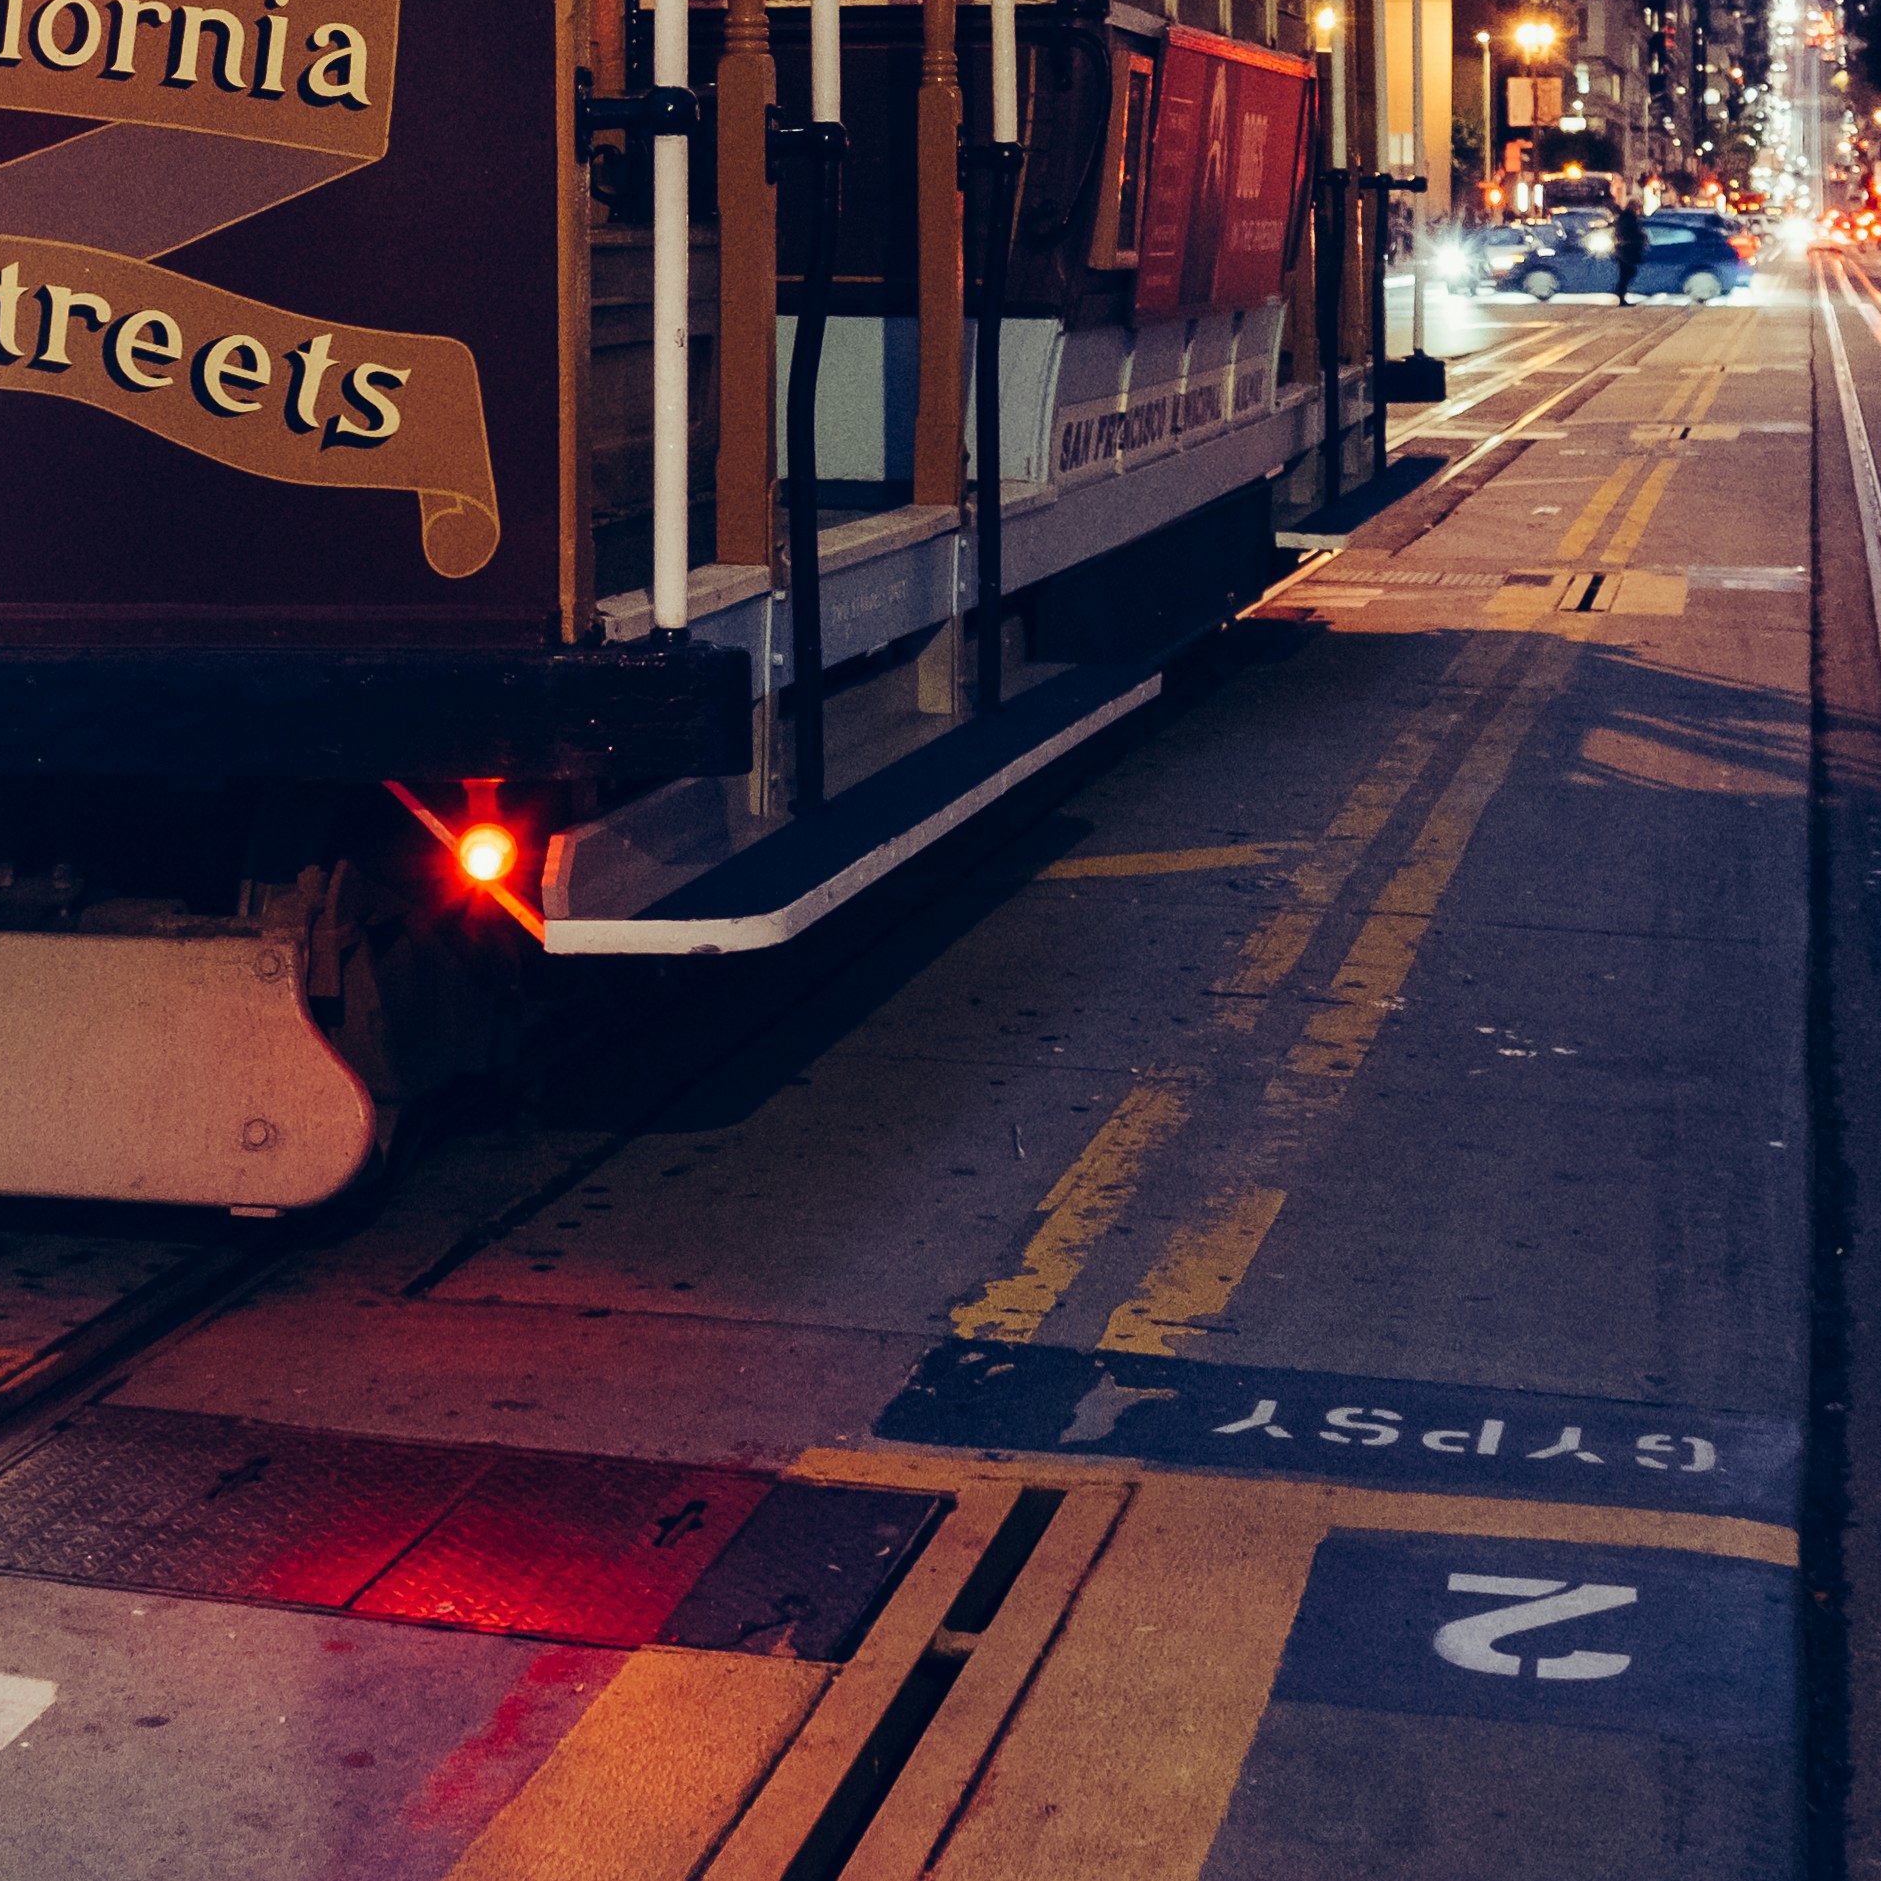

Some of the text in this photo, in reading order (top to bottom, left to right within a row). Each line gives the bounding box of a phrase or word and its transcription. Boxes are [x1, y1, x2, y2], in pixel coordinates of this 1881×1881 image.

[1059, 418, 1095, 473] SAN
[1214, 1398, 1718, 1475] GYPSY
[1433, 1571, 1639, 1681] 2
